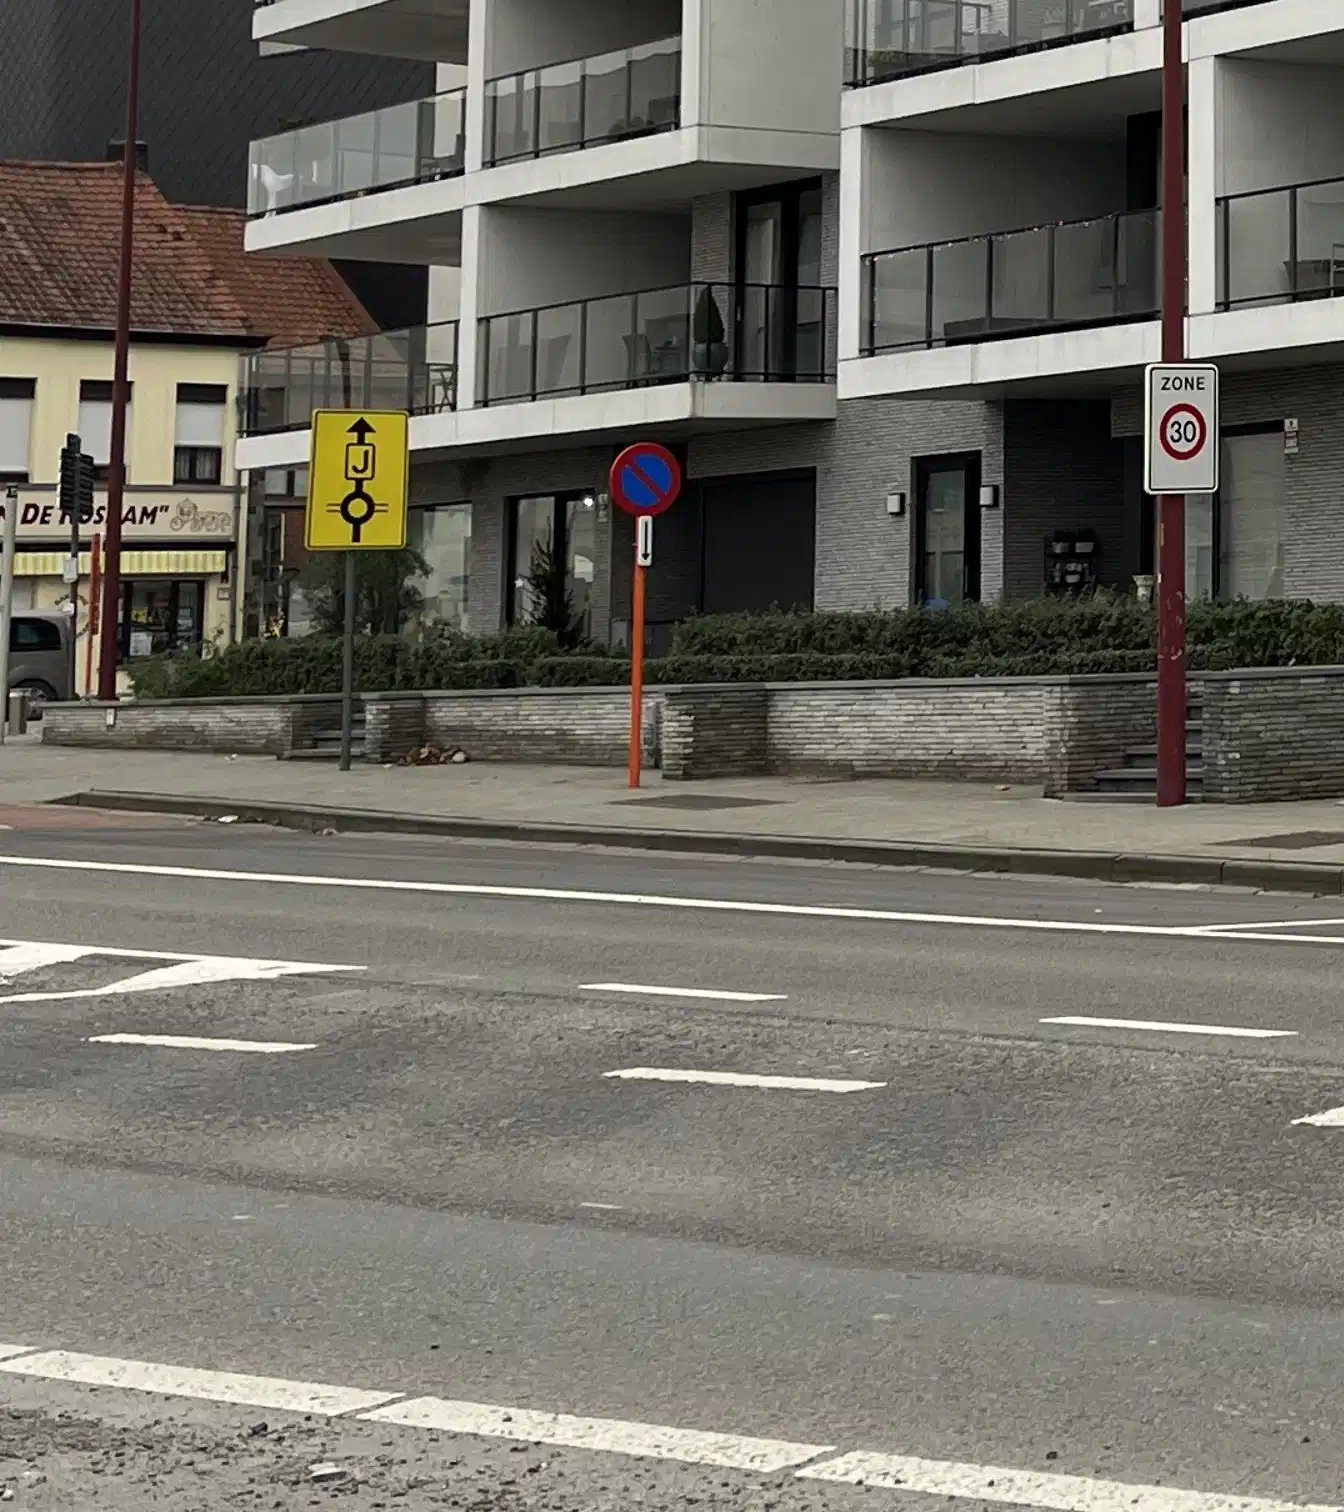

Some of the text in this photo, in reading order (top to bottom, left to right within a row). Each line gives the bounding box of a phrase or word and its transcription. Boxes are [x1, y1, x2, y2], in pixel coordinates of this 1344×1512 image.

[1160, 376, 1206, 391] ZONE
[1170, 420, 1197, 444] 30
[351, 449, 370, 474] J
[20, 503, 55, 525] DE
